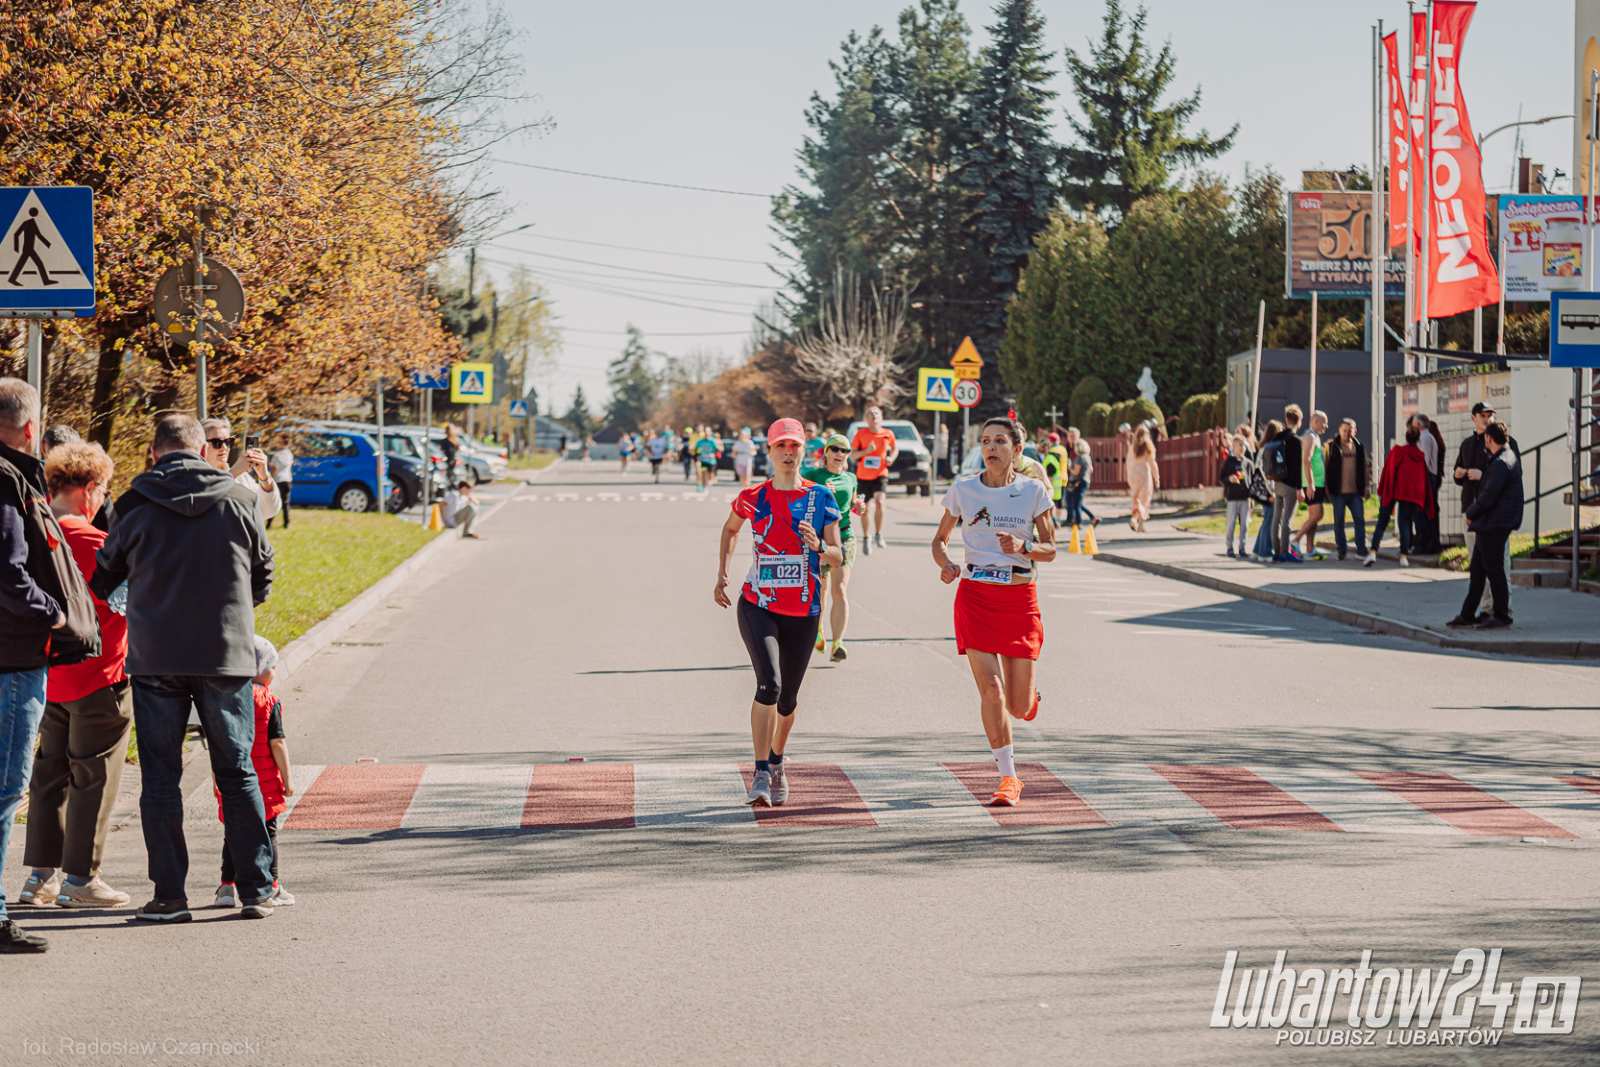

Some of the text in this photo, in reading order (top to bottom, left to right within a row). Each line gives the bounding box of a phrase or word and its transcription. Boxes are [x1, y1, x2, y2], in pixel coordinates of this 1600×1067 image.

[1432, 30, 1479, 283] NEONET
[957, 386, 977, 400] 30
[993, 516, 1026, 525] MARATON
[776, 565, 799, 578] 022
